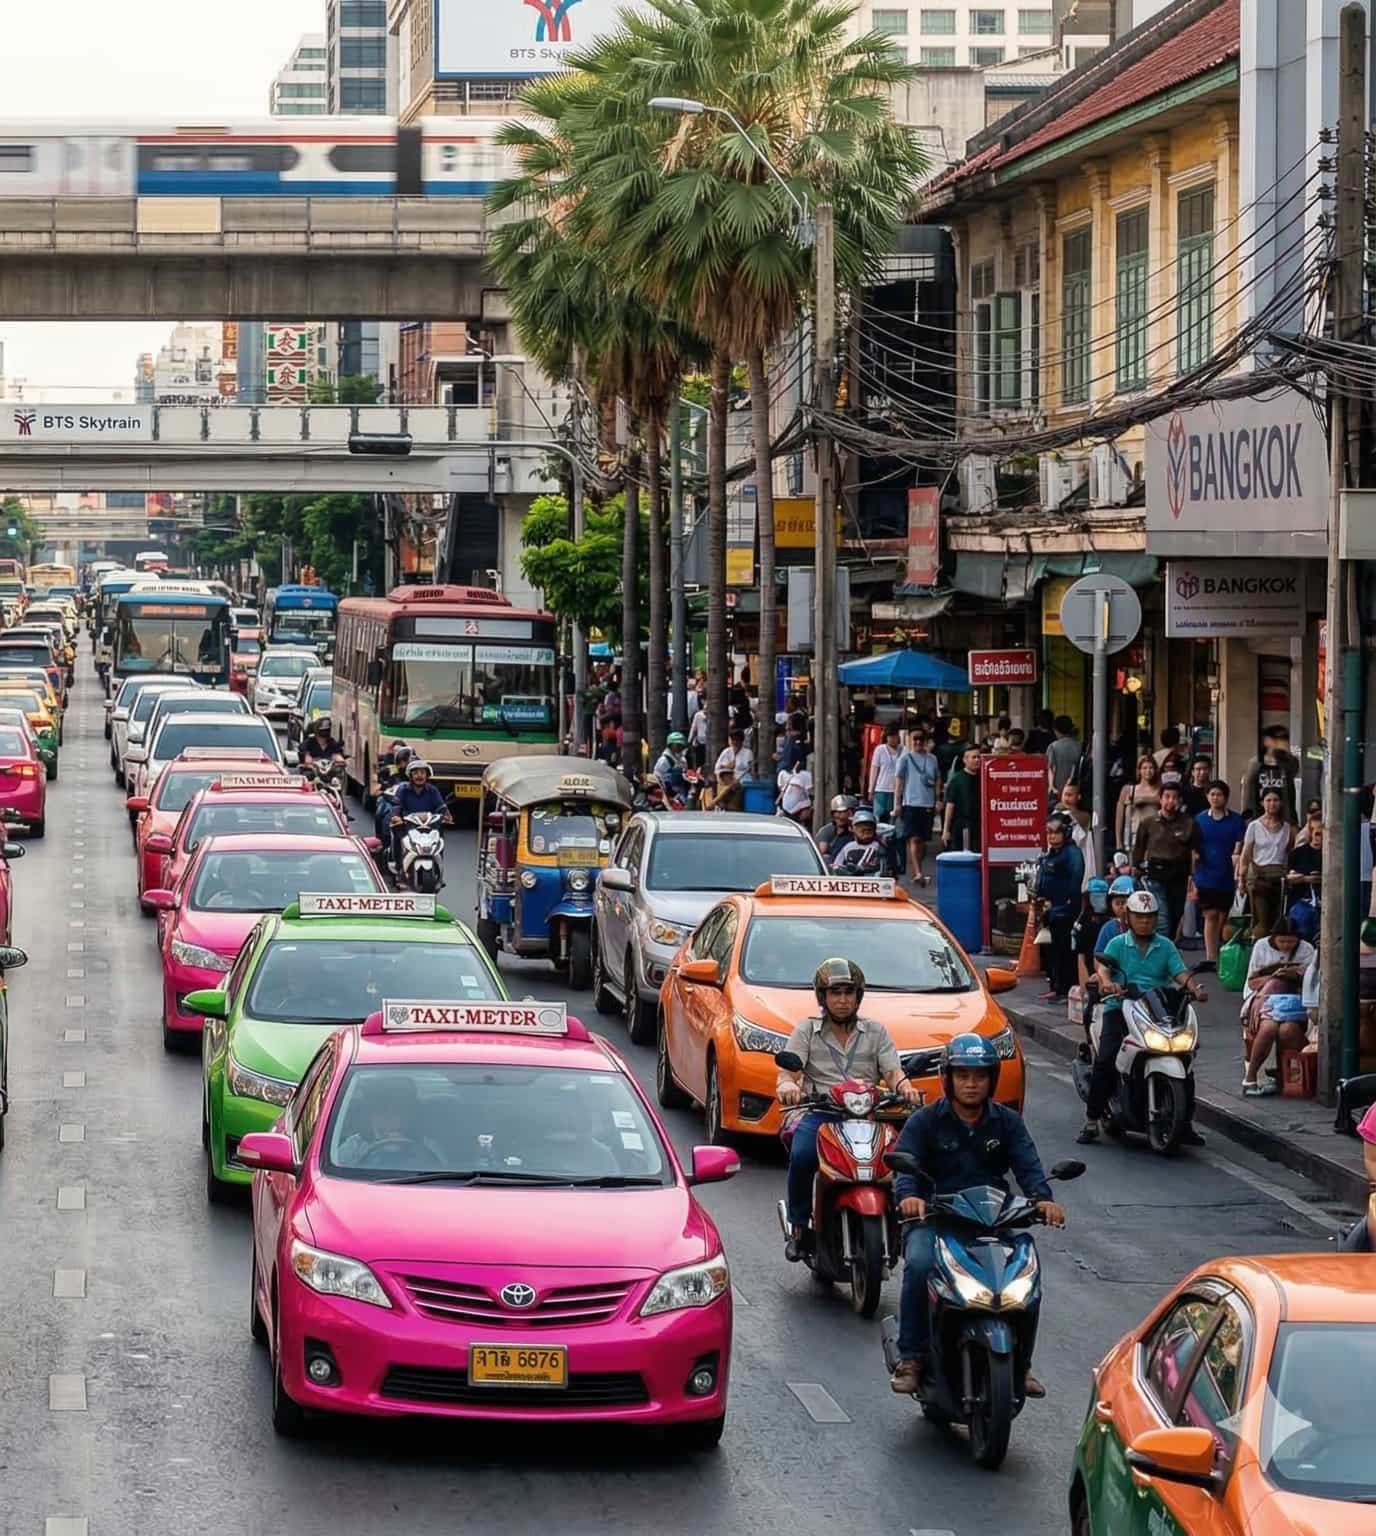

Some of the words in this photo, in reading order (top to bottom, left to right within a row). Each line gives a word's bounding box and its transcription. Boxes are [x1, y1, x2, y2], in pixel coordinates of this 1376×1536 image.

[510, 48, 536, 59] BTS
[43, 416, 74, 428] BTS
[79, 416, 141, 431] Skytrain
[1189, 423, 1303, 501] BANGKOK
[1204, 578, 1297, 594] BANGKOK
[789, 880, 881, 894] TAXI-METER
[316, 898, 415, 911] TAXI-METER
[411, 1009, 537, 1027] TAXI-METER
